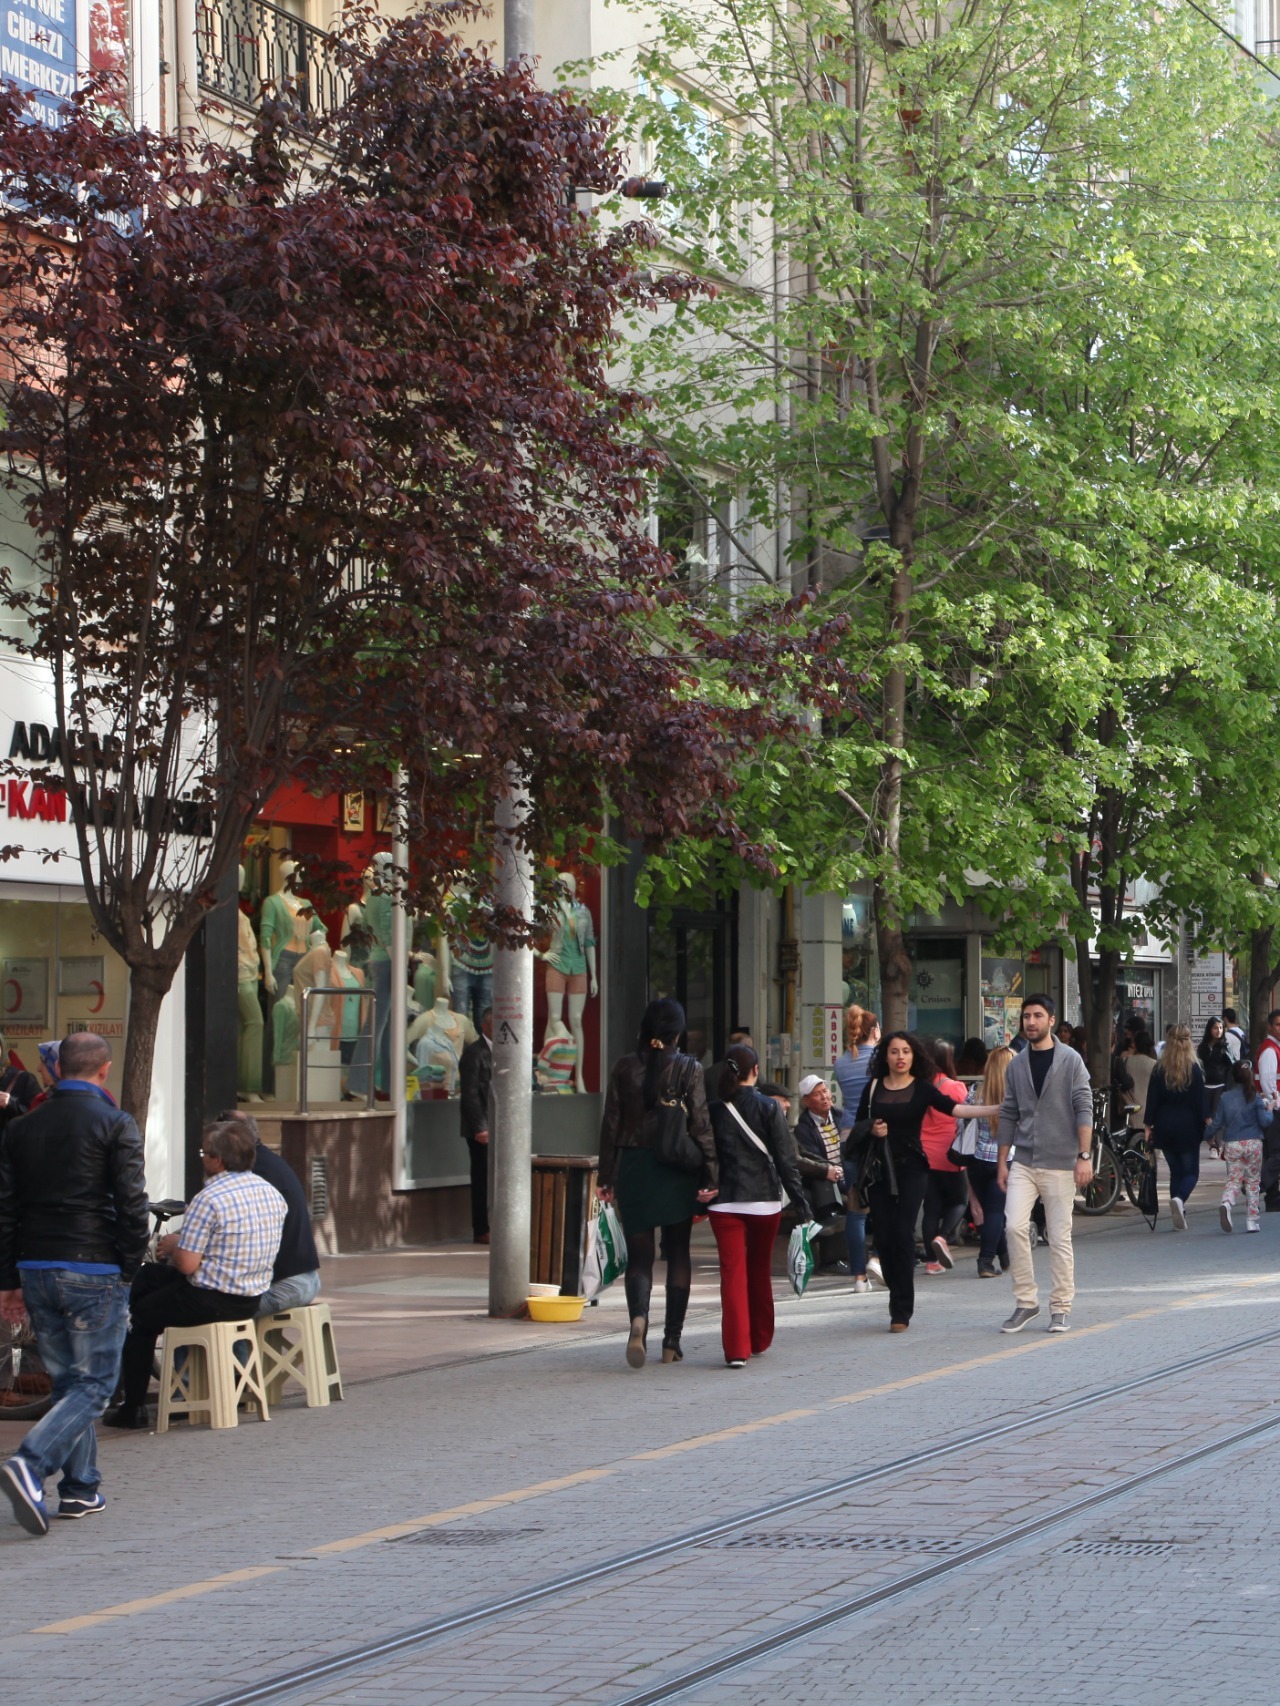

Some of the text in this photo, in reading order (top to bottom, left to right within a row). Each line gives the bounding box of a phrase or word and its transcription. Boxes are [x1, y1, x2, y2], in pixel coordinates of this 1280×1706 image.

[8, 10, 64, 60] CİHAZI
[1, 45, 76, 101] MERKEZİ
[812, 1006, 824, 1057] ABONE
